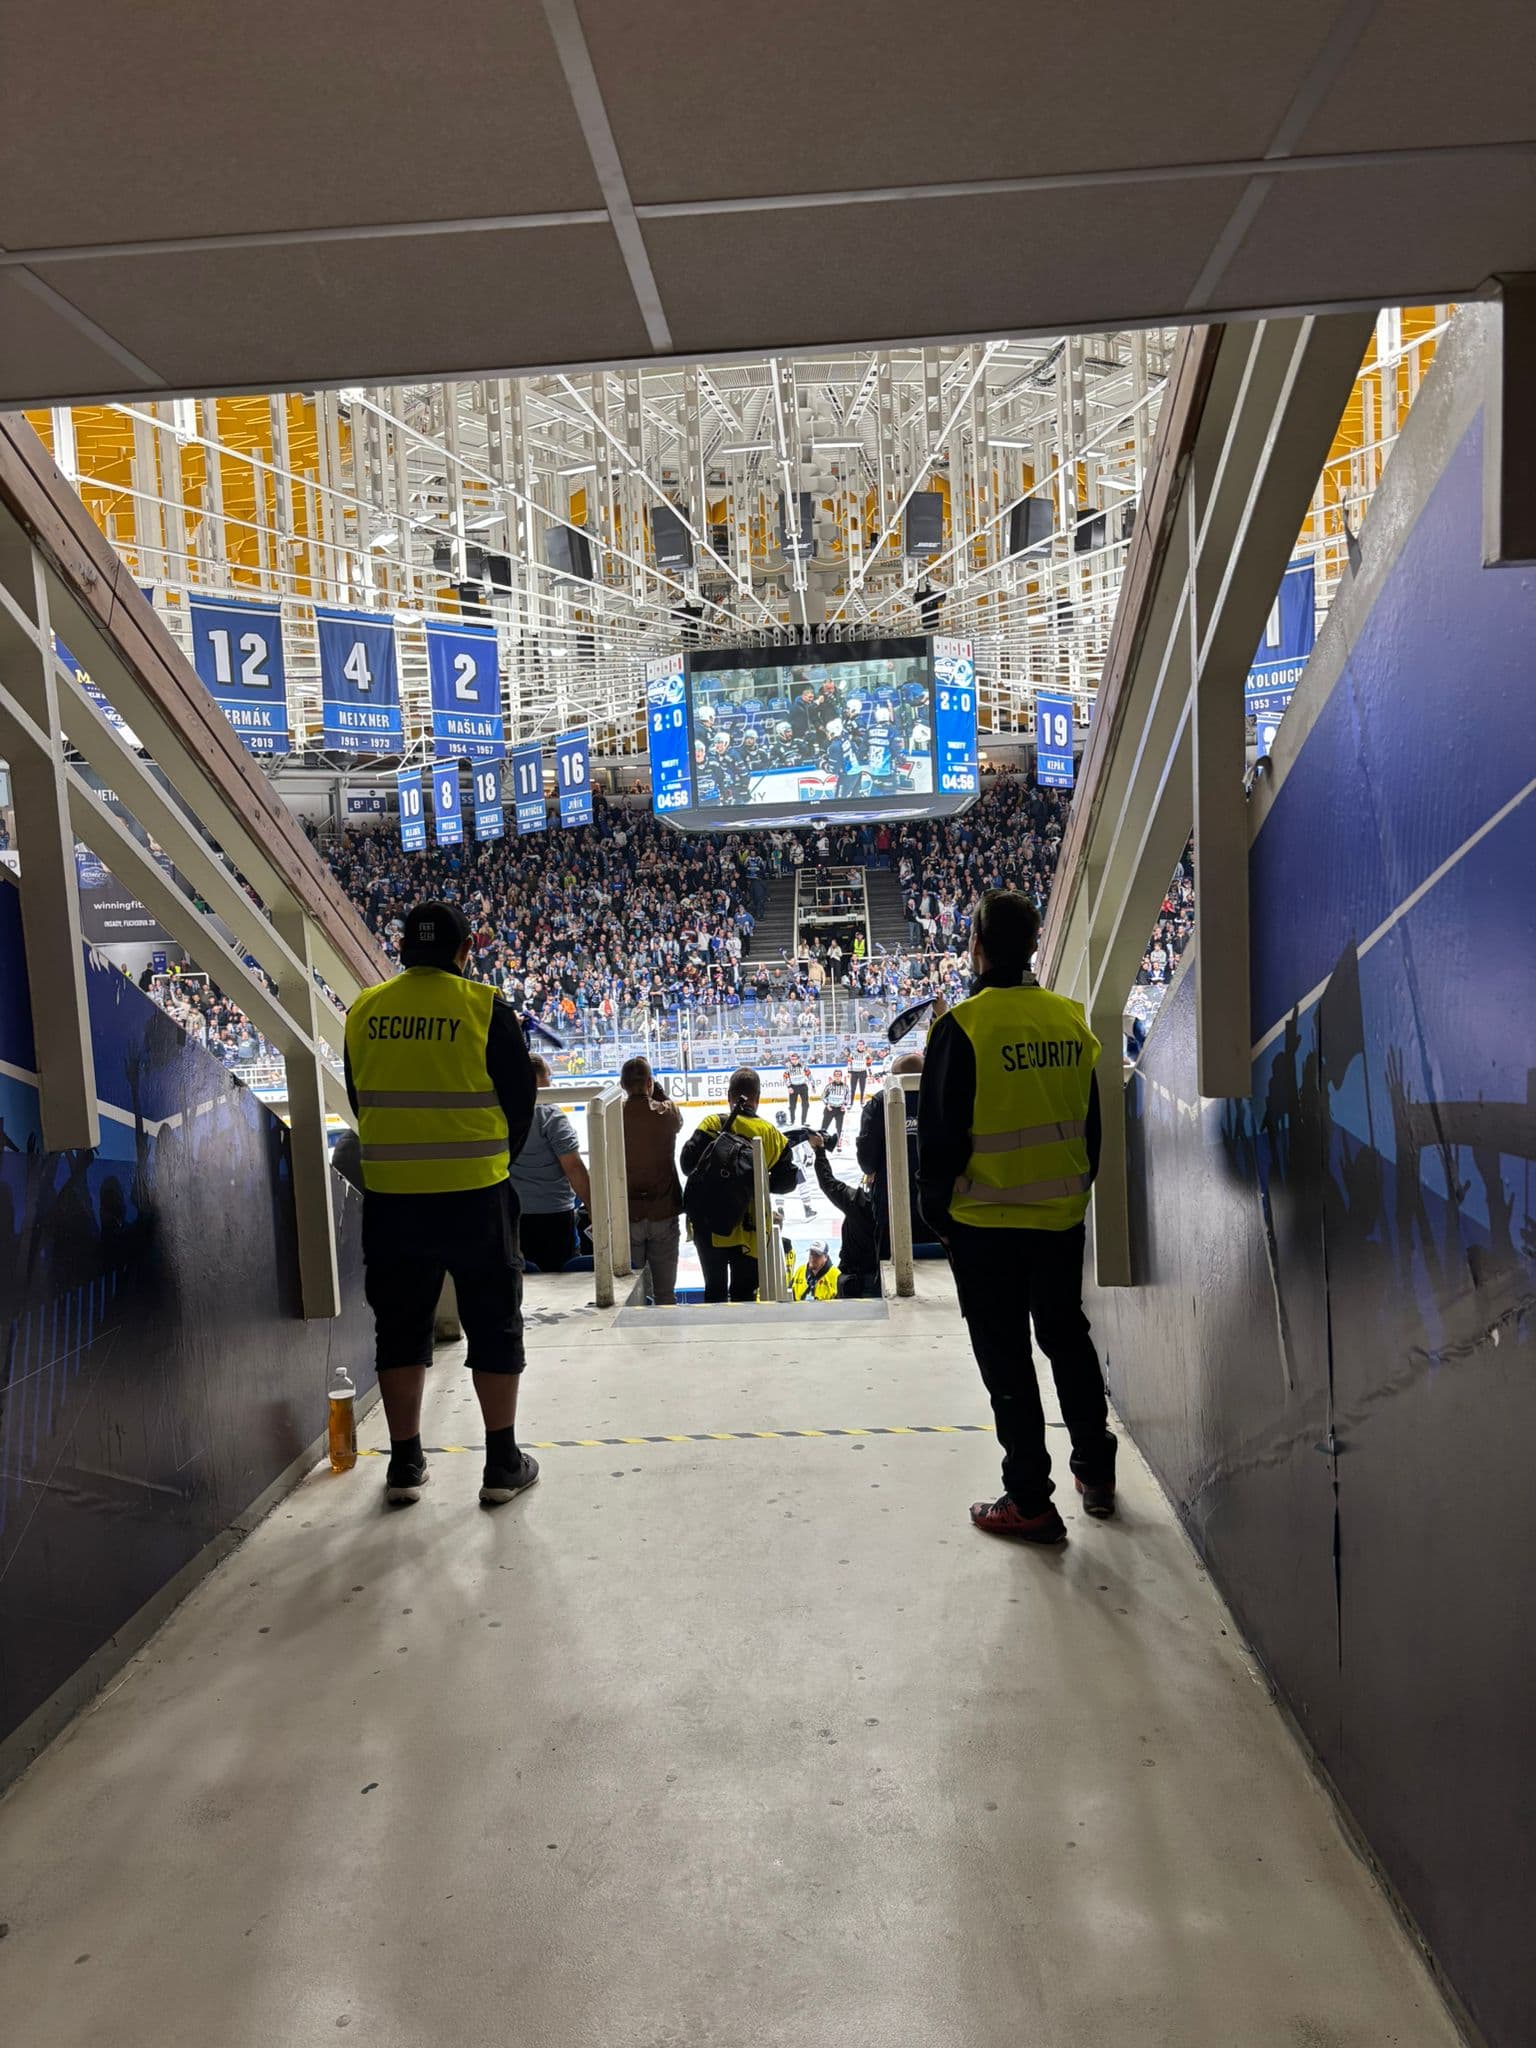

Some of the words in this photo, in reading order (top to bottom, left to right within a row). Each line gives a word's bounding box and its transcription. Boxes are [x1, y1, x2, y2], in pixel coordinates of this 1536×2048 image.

[208, 629, 270, 686] 12
[343, 642, 371, 690] 4
[454, 653, 478, 700] 2
[1247, 667, 1303, 690] KOLOUCH
[219, 707, 272, 726] ERMÁK
[1250, 698, 1270, 711] 1953
[339, 711, 390, 728] MEIXNER
[447, 719, 492, 737] MAŠLAŇ
[1042, 712, 1067, 747] 19
[251, 737, 274, 748] 2019
[341, 736, 359, 747] 1961
[371, 738, 390, 748] 1973
[449, 743, 466, 753] 1954
[476, 745, 493, 755] 1967
[519, 762, 537, 794] 11
[561, 752, 585, 786] 16
[441, 781, 452, 809] 8
[476, 772, 496, 803] 18
[402, 788, 419, 817] 10
[368, 1016, 462, 1042] SECURITY
[1002, 1040, 1084, 1072] SECURITY
[707, 1075, 730, 1085] REA
[708, 1088, 729, 1097] EST
